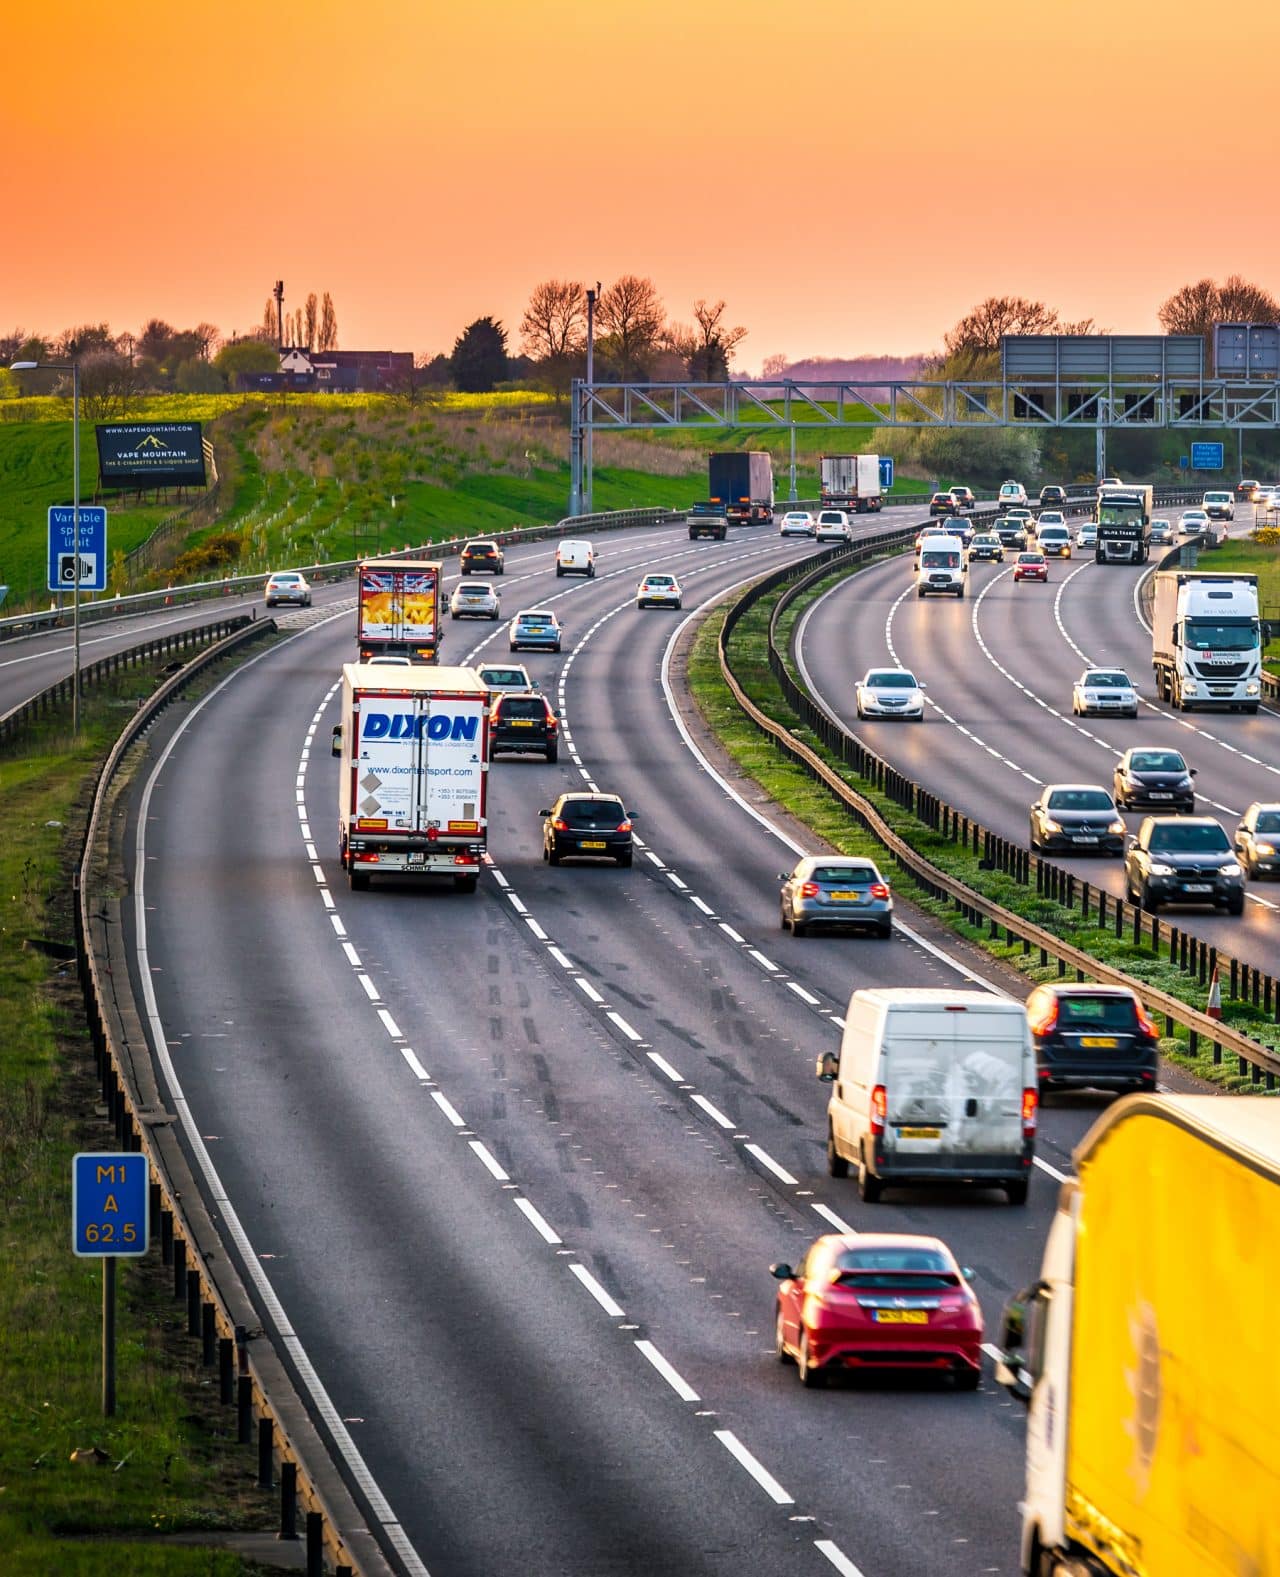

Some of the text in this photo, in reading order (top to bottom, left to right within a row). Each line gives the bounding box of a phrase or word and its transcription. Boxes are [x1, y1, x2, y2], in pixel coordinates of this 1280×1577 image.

[105, 425, 193, 434] WWW.VAPEMOUNTAIN.COM
[54, 512, 101, 523] Varble
[60, 525, 94, 536] sped
[363, 713, 479, 741] DIXON
[96, 1165, 126, 1184] M1
[103, 1194, 119, 1213] A
[85, 1223, 137, 1243] 62.5
